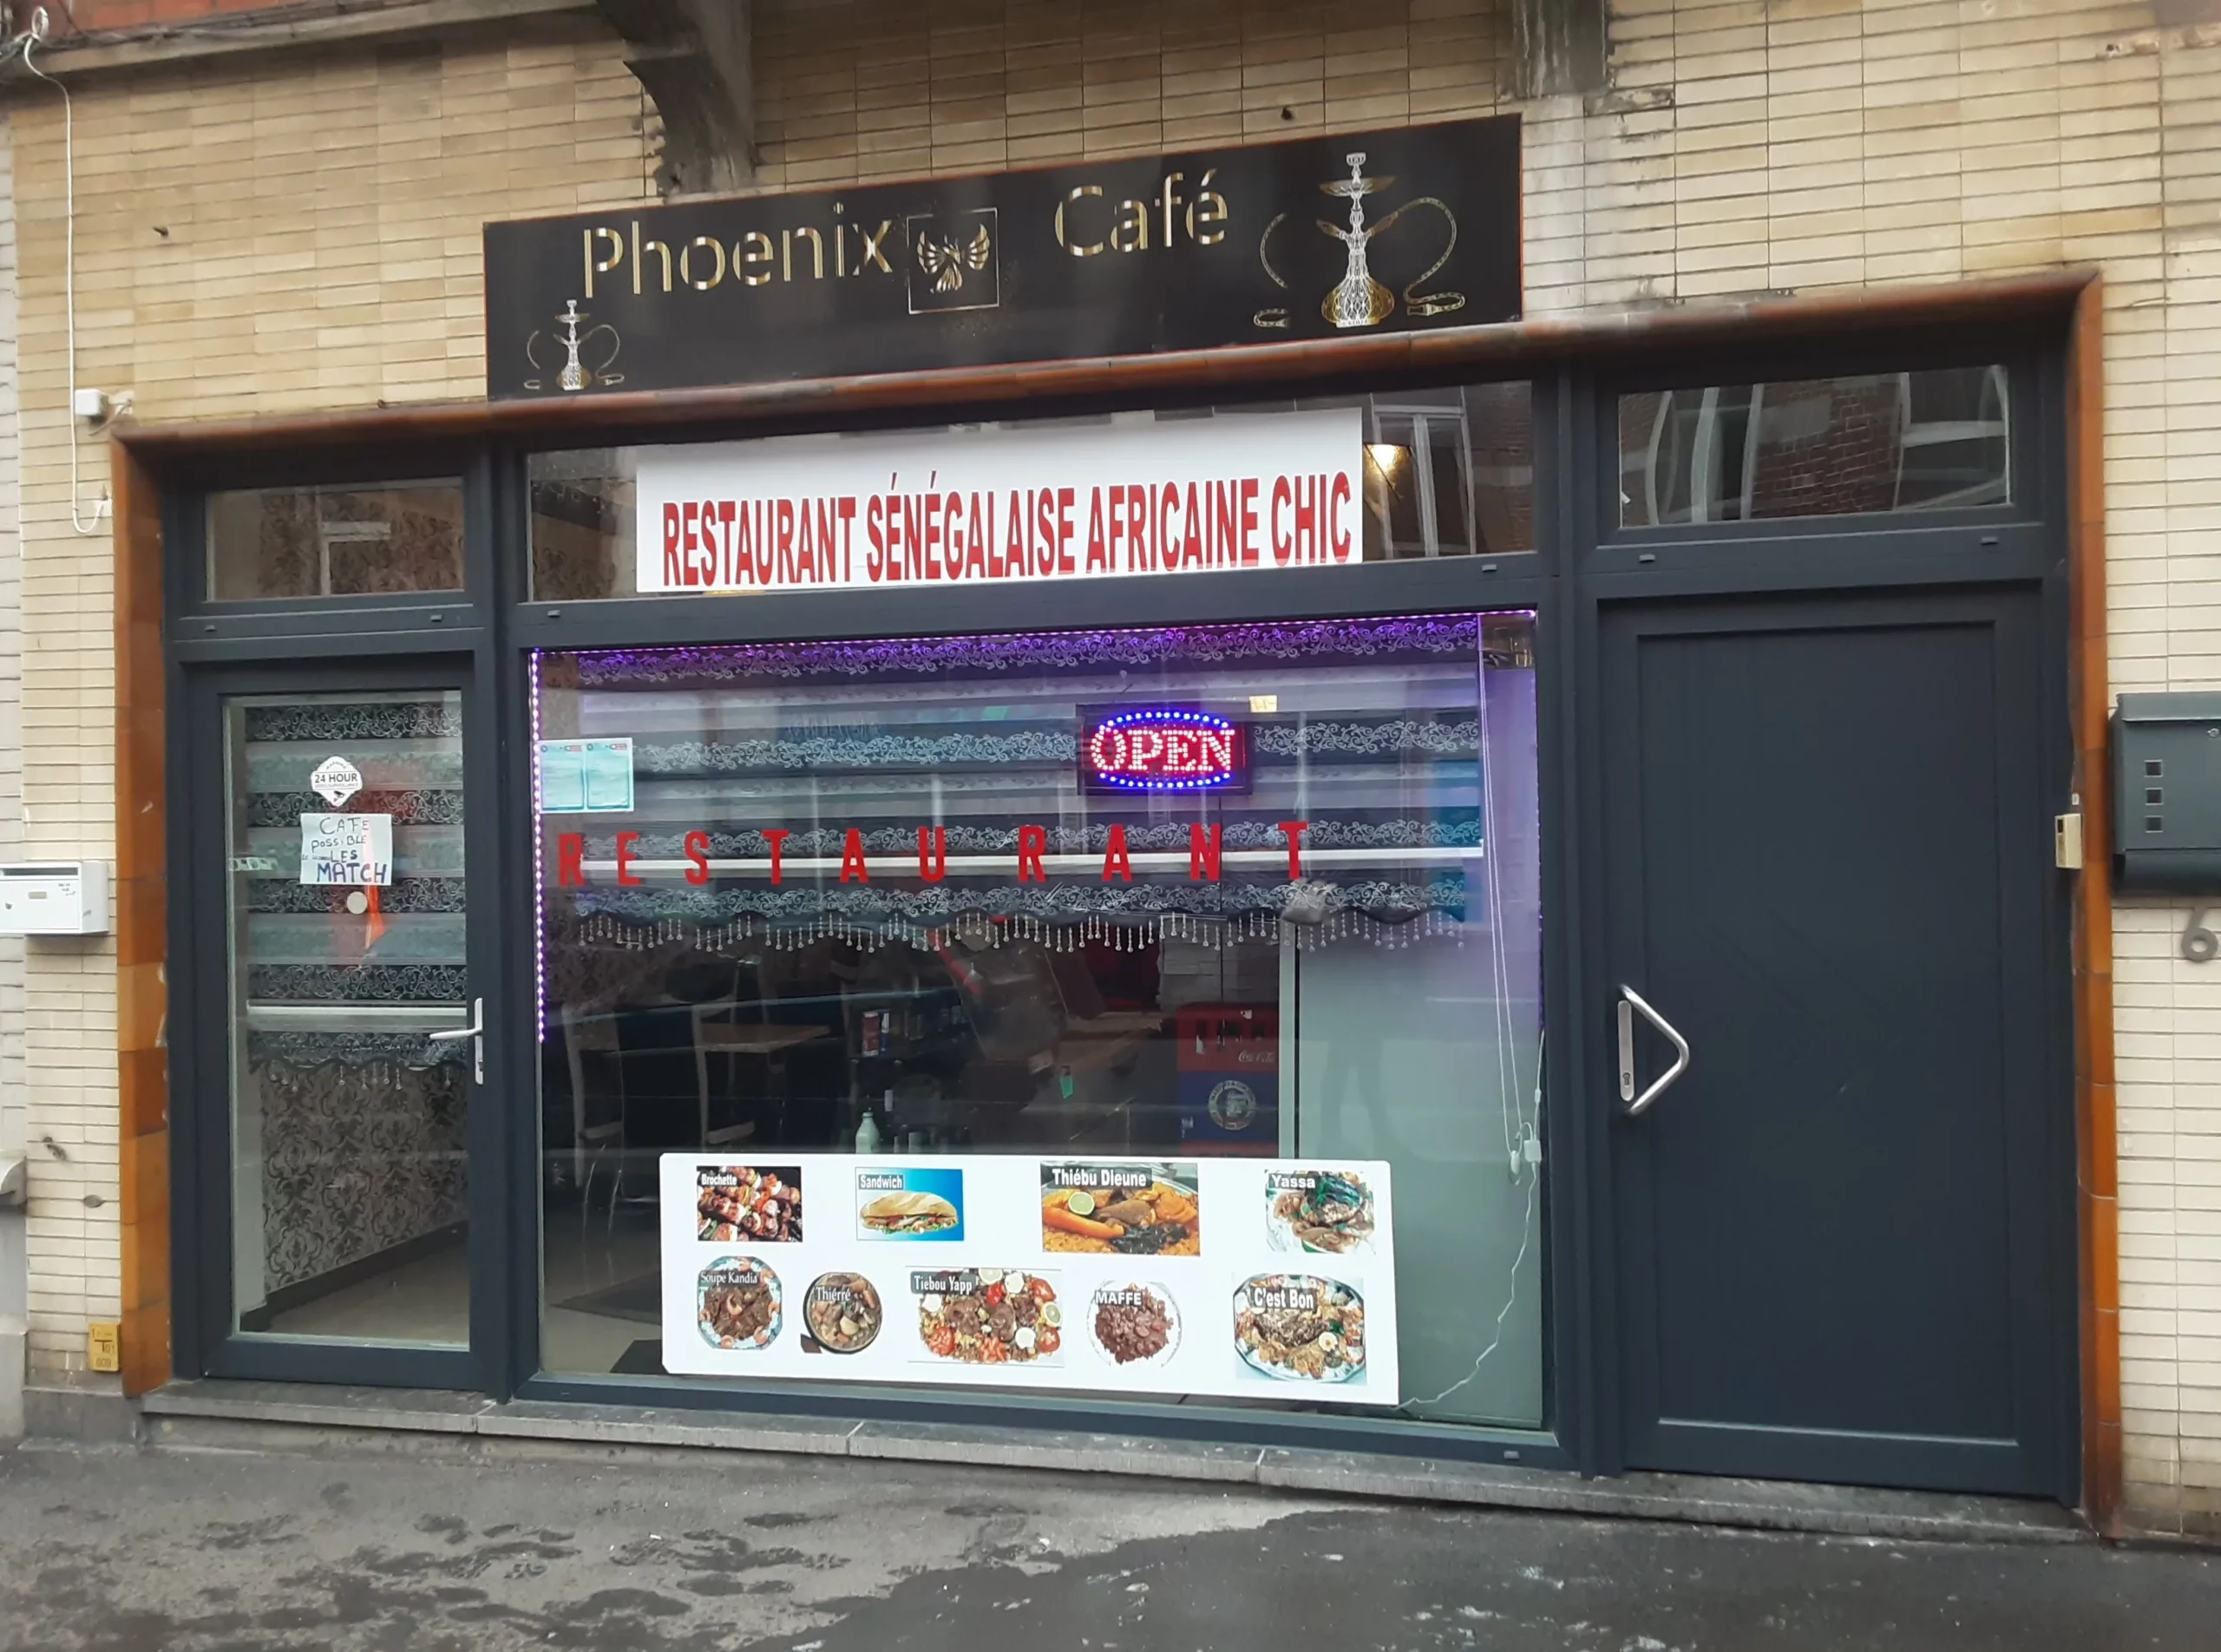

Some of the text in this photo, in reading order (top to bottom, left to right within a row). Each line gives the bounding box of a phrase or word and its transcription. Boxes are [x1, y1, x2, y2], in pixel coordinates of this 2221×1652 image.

[583, 167, 1228, 298] Phoenix Café
[663, 469, 1352, 587] RESTAURANT SÉNÉGALAISE AFRICAINE CHIC
[1090, 727, 1235, 771] OPEN
[314, 772, 358, 783] 24 HOUR
[331, 849, 358, 863] LES
[558, 821, 1308, 886] RESTAURANT
[317, 862, 388, 883] MATCH
[2180, 907, 2218, 963] 6
[701, 1172, 737, 1186] Brochette
[860, 1174, 903, 1190] Sandwich
[1052, 1167, 1147, 1187] Thiébu Dieune
[1271, 1174, 1316, 1189] Yassa
[700, 1271, 758, 1287] Soupe Kandia
[914, 1275, 973, 1295] Tiebou Yapp
[1095, 1291, 1142, 1306] MAFFE
[1254, 1287, 1314, 1309] C'est Bon
